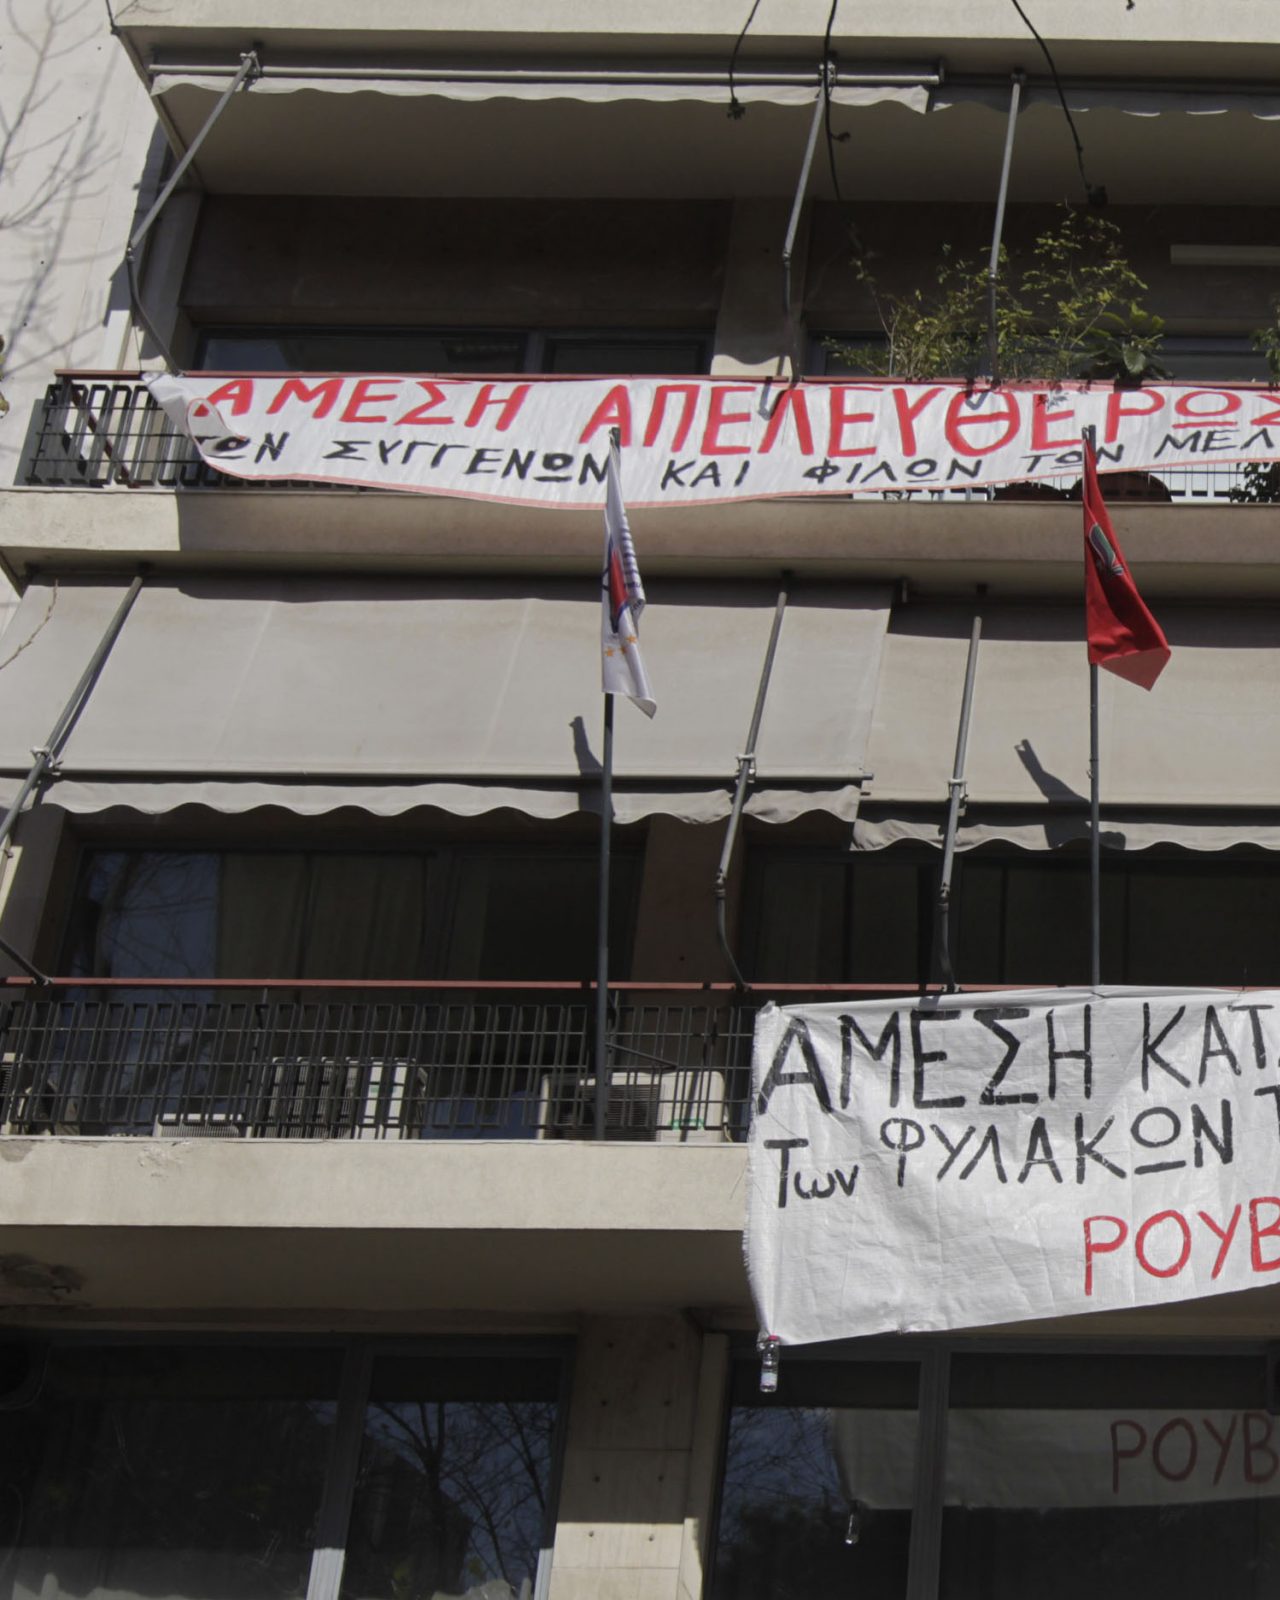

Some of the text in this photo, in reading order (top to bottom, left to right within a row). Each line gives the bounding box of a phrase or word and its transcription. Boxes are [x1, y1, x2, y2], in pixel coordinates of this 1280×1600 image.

[193, 378, 533, 431] ΑΜΕΣΗ
[323, 438, 609, 484] ΣΥΓΓΕΝΩΝ
[661, 459, 750, 491] ΚΑΙ
[802, 458, 983, 485] ΦΙΛΩΝ
[1020, 444, 1125, 473] ΤΩΝ
[758, 1003, 1092, 1115] ΑΜΕΣΗ
[879, 1099, 1234, 1187] ΦΥΛΑΚΩΝ
